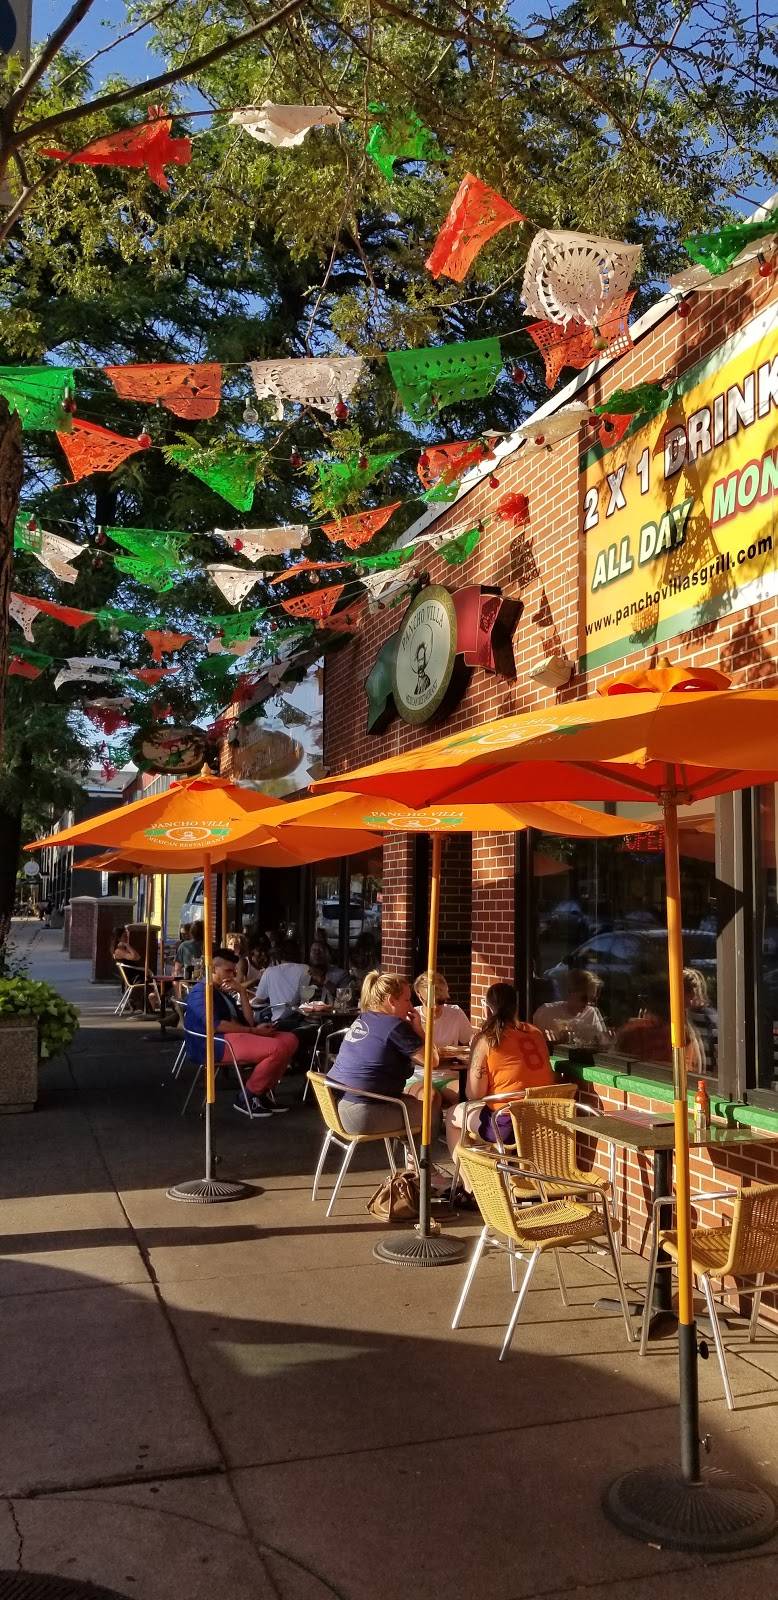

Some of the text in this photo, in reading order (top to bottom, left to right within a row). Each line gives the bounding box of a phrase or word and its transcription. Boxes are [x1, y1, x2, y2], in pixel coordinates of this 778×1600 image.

[584, 487, 600, 532] 2
[605, 463, 627, 518] X
[637, 446, 650, 495] 1
[591, 537, 634, 591] ALL
[638, 499, 693, 566] DAY
[585, 534, 773, 637] www.panchovillasgrill.com
[401, 605, 444, 651] PANCHO VILLA
[150, 820, 198, 830] PANCHO
[518, 1038, 545, 1071] 8
